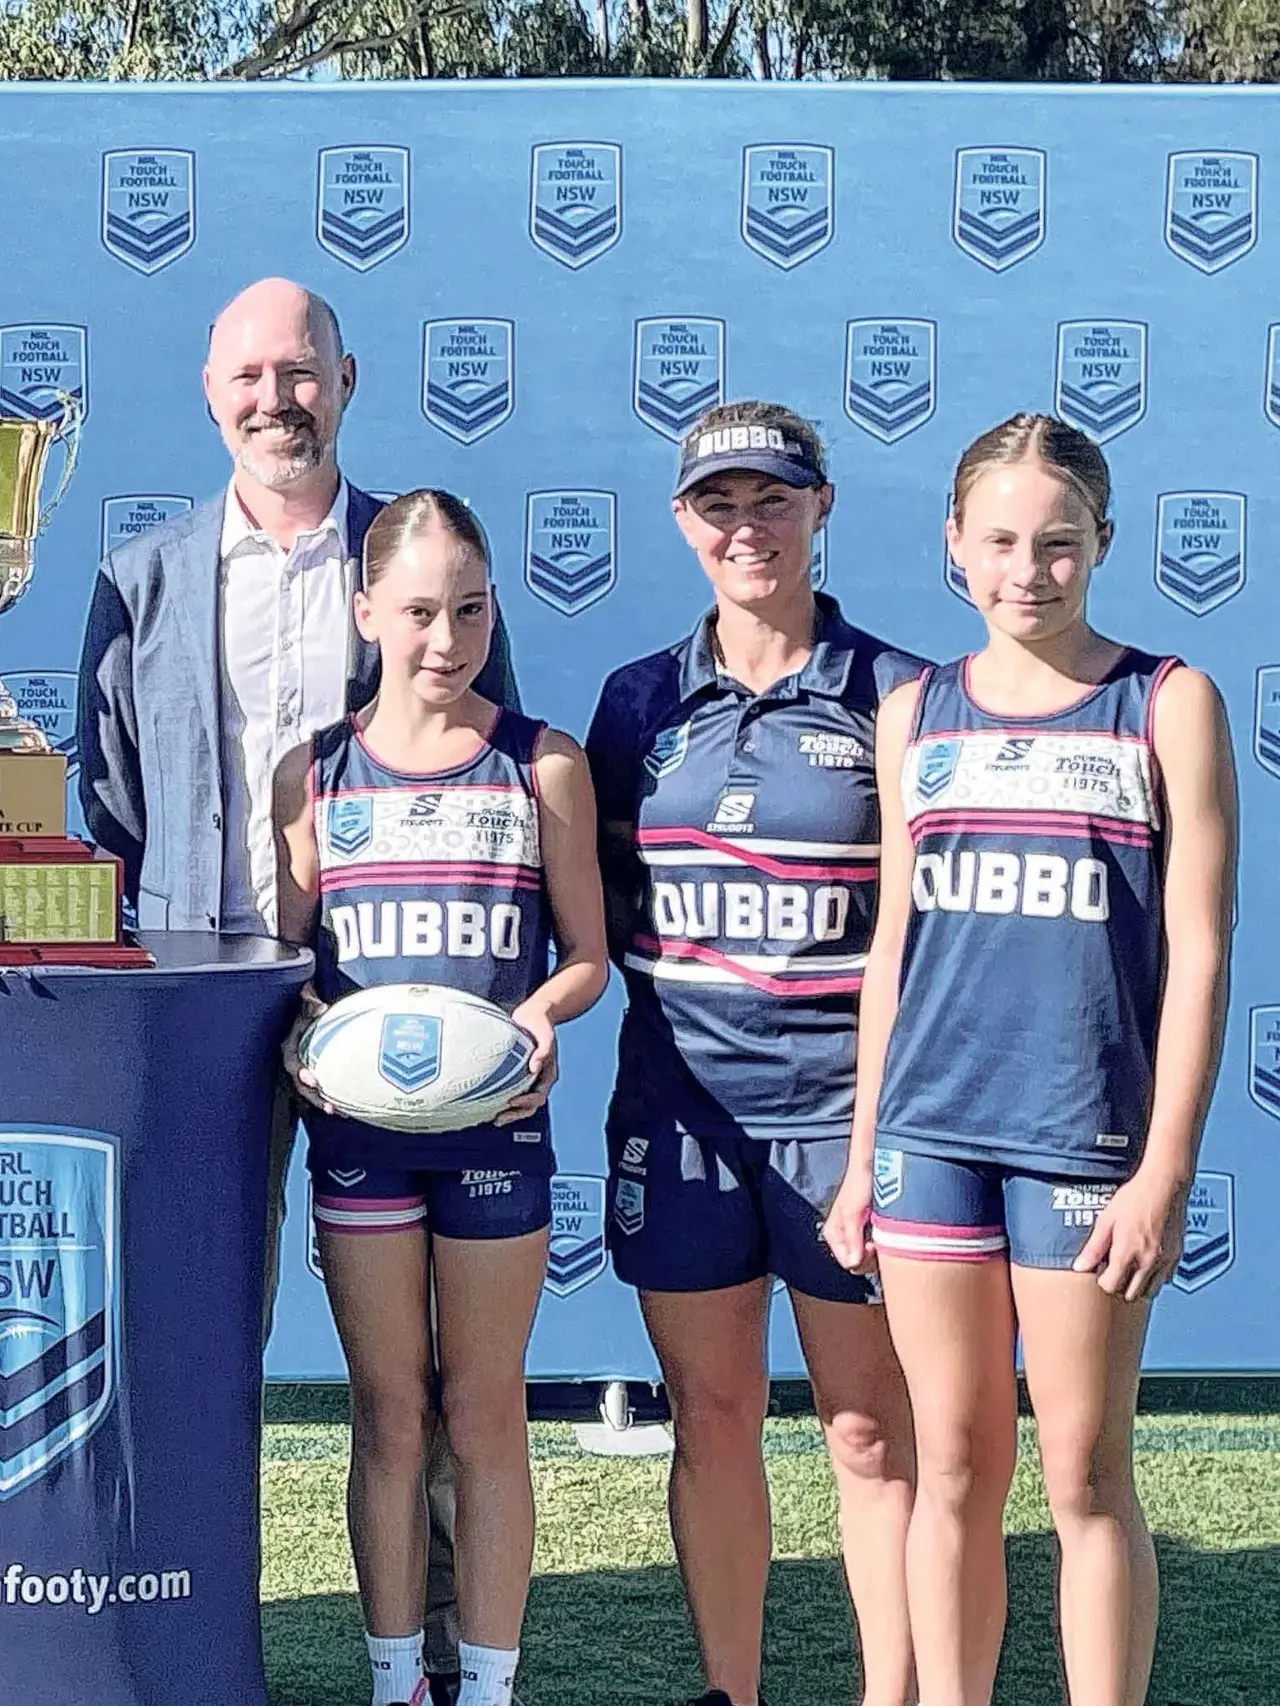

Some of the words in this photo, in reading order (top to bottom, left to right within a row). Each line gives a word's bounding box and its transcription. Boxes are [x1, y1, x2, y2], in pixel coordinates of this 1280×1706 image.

[345, 162, 382, 172] TOUCH
[559, 159, 594, 168] TOUCH
[770, 161, 806, 170] TOUCH
[983, 164, 1018, 173] TOUCH
[130, 166, 166, 175] TOUCH
[548, 169, 605, 180] FOOTBALL
[1195, 167, 1231, 176] TOUCH
[120, 176, 178, 187] FOOTBALL
[336, 173, 393, 183] FOOTBALL
[761, 171, 817, 182] FOOTBALL
[973, 174, 1028, 185] FOOTBALL
[1185, 177, 1240, 188] FOOTBALL
[344, 189, 383, 203] NSW
[557, 185, 595, 200] NSW
[769, 187, 807, 202] NSW
[981, 190, 1019, 205] NSW
[129, 192, 168, 207] NSW
[1193, 193, 1231, 208] NSW
[451, 335, 486, 344] TOUCH
[662, 334, 698, 343] TOUCH
[873, 335, 909, 344] TOUCH
[1084, 337, 1120, 346] TOUCH
[23, 341, 59, 351] TOUCH
[441, 345, 496, 356] FOOTBALL
[653, 344, 708, 355] FOOTBALL
[864, 345, 919, 356] FOOTBALL
[13, 352, 70, 362] FOOTBALL
[1075, 347, 1130, 358] FOOTBALL
[449, 361, 487, 376] NSW
[661, 360, 699, 375] NSW
[872, 361, 910, 376] NSW
[1083, 363, 1121, 378] NSW
[22, 368, 61, 382] NSW
[697, 425, 786, 458] DUBBO
[129, 512, 166, 522] TOUCH
[553, 507, 589, 516] TOUCH
[1184, 508, 1219, 517] TOUCH
[544, 517, 600, 528] FOOTBALL
[1174, 518, 1229, 529] FOOTBALL
[552, 533, 590, 548] NSW
[1182, 534, 1220, 549] NSW
[21, 688, 57, 697] TOUCH
[17, 698, 69, 709] OOTBALL
[1055, 758, 1122, 777] Touch
[1073, 778, 1110, 794] 1975
[16, 823, 43, 834] CUP
[912, 850, 1110, 923] DUBBO
[654, 880, 851, 941] DUBBO
[329, 899, 521, 963] DUBBO
[1053, 1187, 1113, 1207] Touc
[551, 1217, 581, 1232] SW
